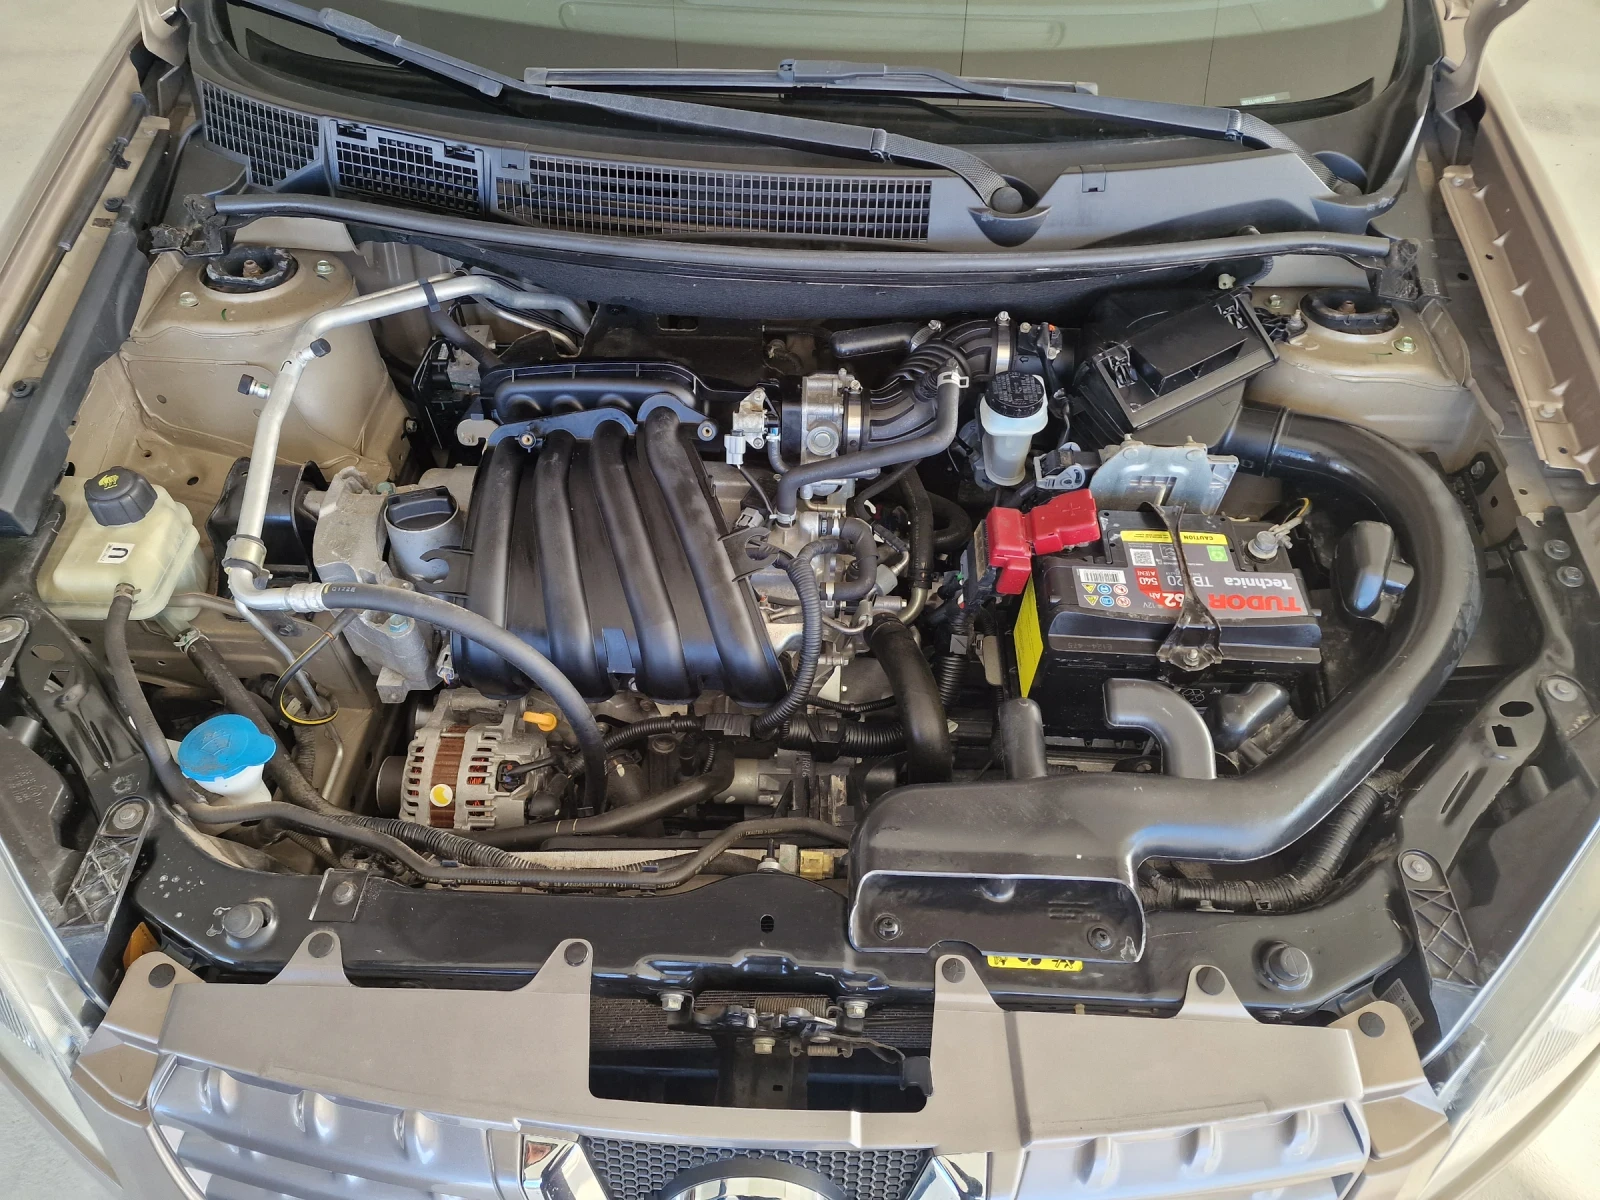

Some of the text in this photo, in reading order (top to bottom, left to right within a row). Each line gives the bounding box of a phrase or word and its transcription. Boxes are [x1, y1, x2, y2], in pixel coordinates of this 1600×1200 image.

[1139, 577, 1158, 586] 540
[1167, 575, 1214, 588] TB20
[1223, 576, 1293, 590] Technica
[1142, 601, 1156, 609] 12V
[1149, 592, 1185, 607] 62 Ah
[1207, 593, 1302, 612] TUDOR
